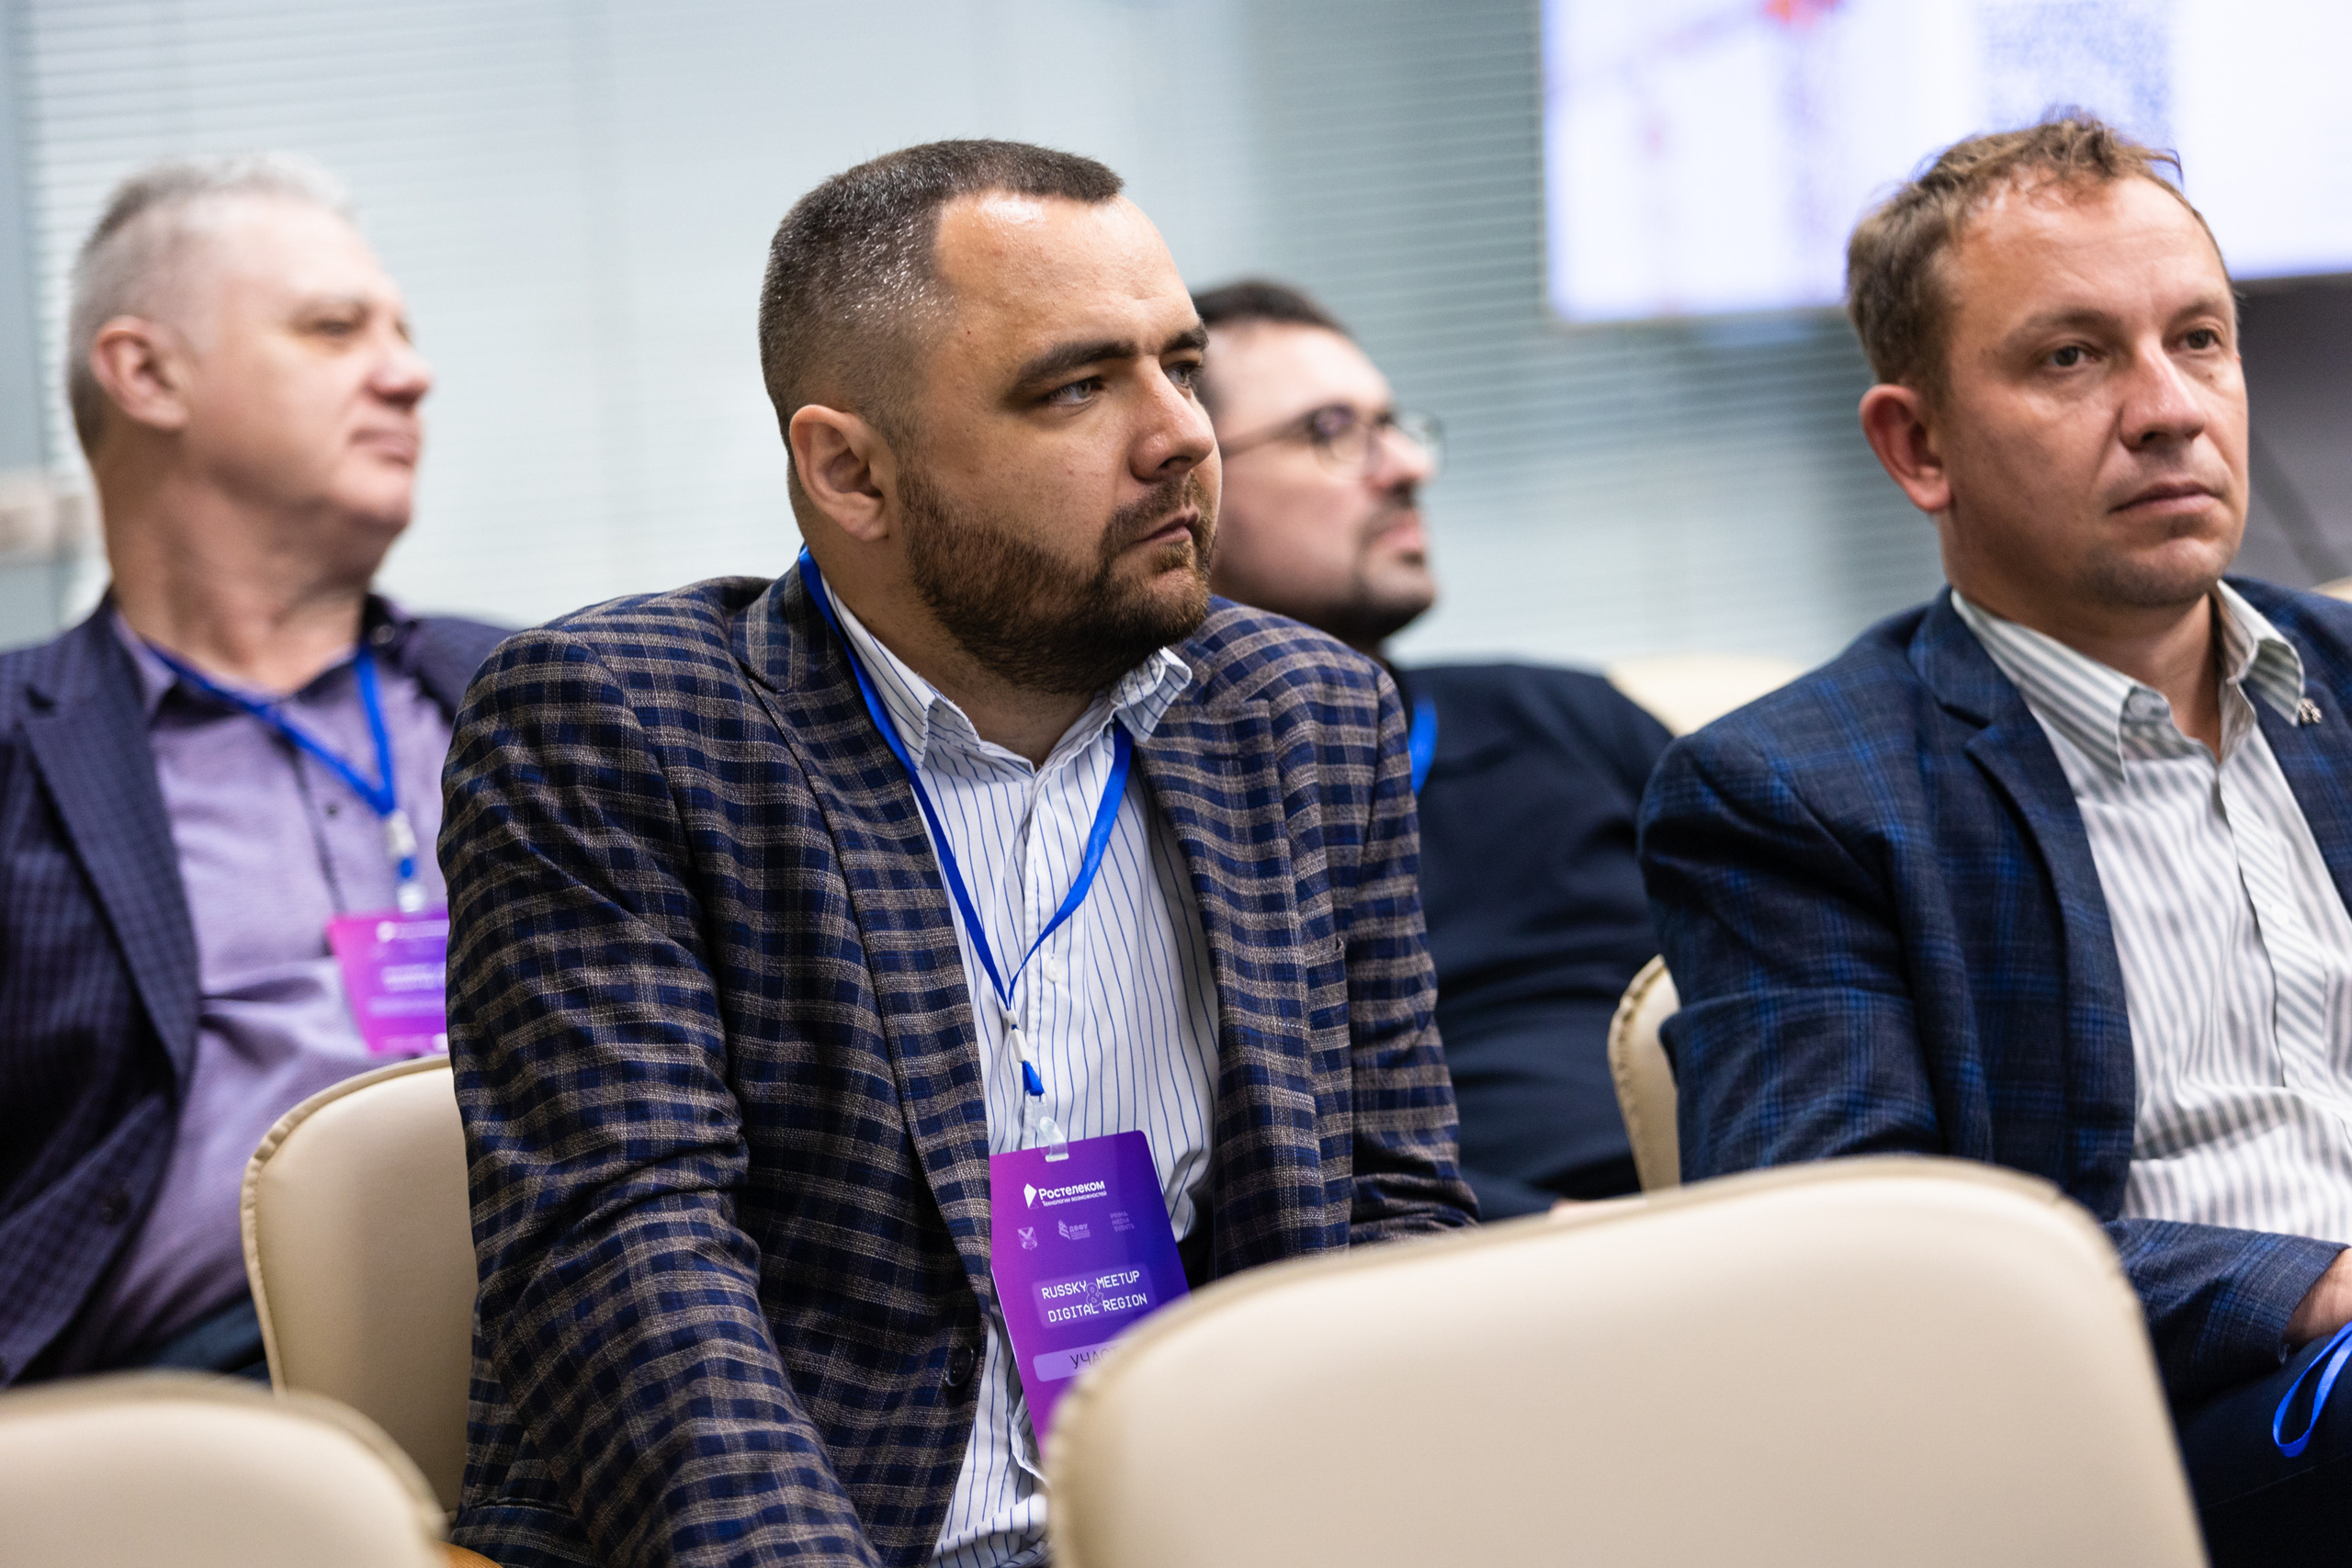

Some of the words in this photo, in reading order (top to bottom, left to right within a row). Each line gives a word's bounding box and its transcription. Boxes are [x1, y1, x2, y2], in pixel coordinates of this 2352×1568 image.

[1038, 1180, 1105, 1200] Ростелеком
[1041, 1280, 1086, 1300] RUSSKY
[1096, 1270, 1140, 1289] MEETUP
[1047, 1303, 1099, 1323] DIGITAL
[1102, 1292, 1148, 1312] REGION
